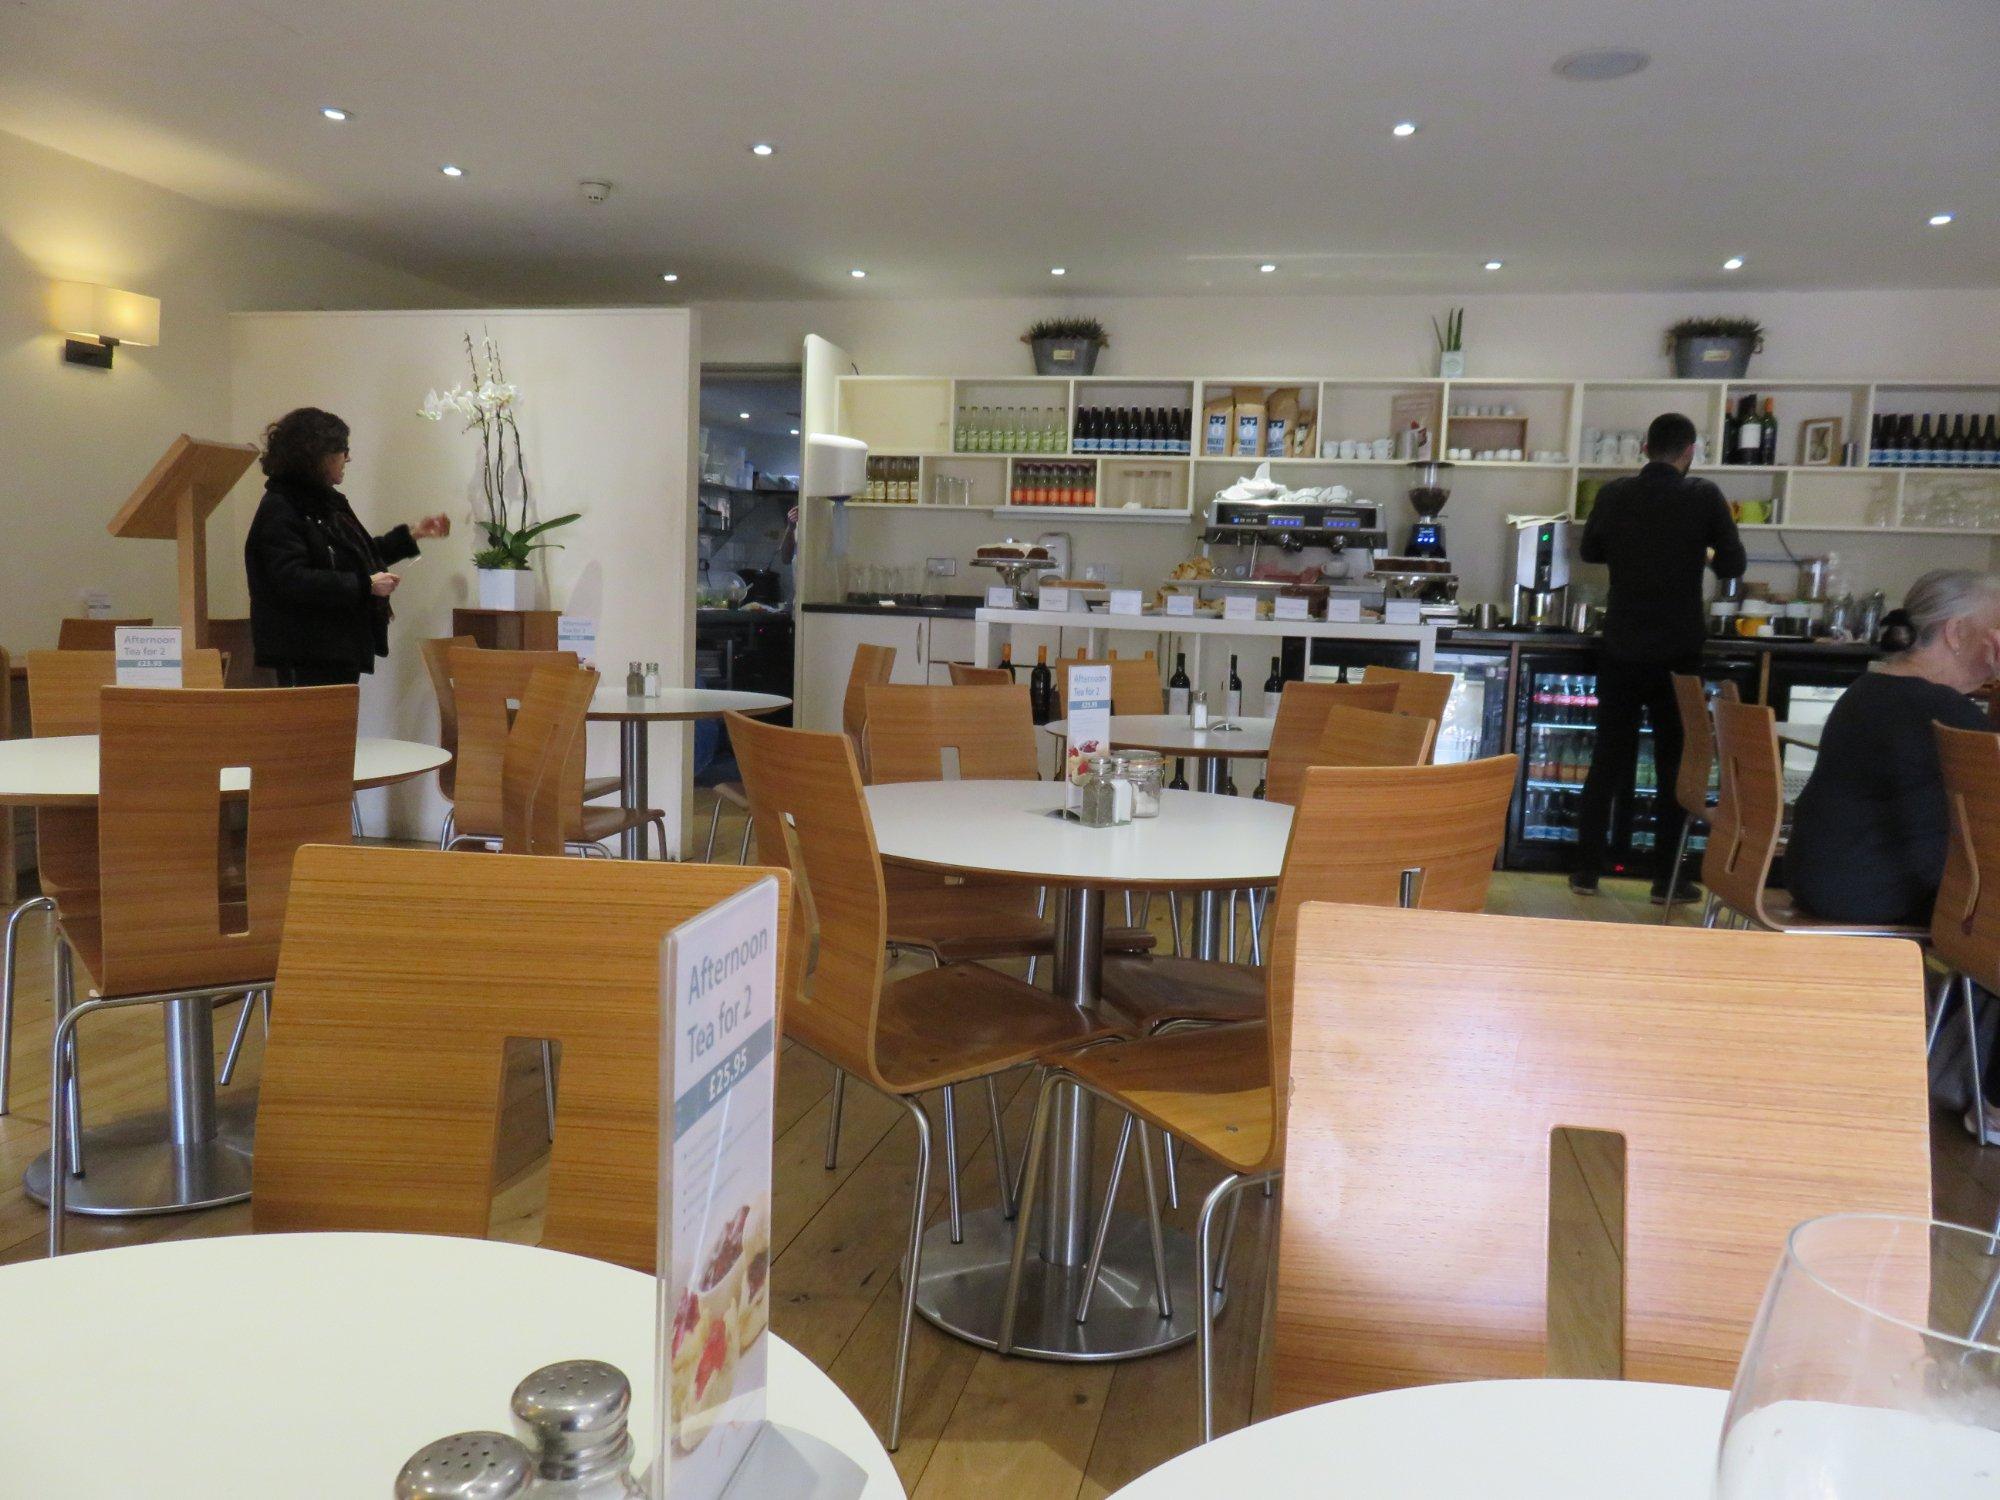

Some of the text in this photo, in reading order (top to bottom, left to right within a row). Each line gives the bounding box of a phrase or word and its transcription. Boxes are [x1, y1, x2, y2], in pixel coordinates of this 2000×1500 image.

[124, 635, 176, 644] Afternoon
[124, 647, 166, 656] Tea for 2
[1073, 672, 1107, 683] Afternoon
[1085, 686, 1095, 696] for
[688, 927, 768, 1005] Afternoon
[687, 984, 752, 1064] Tea for 2
[709, 1047, 747, 1102] £25.95
